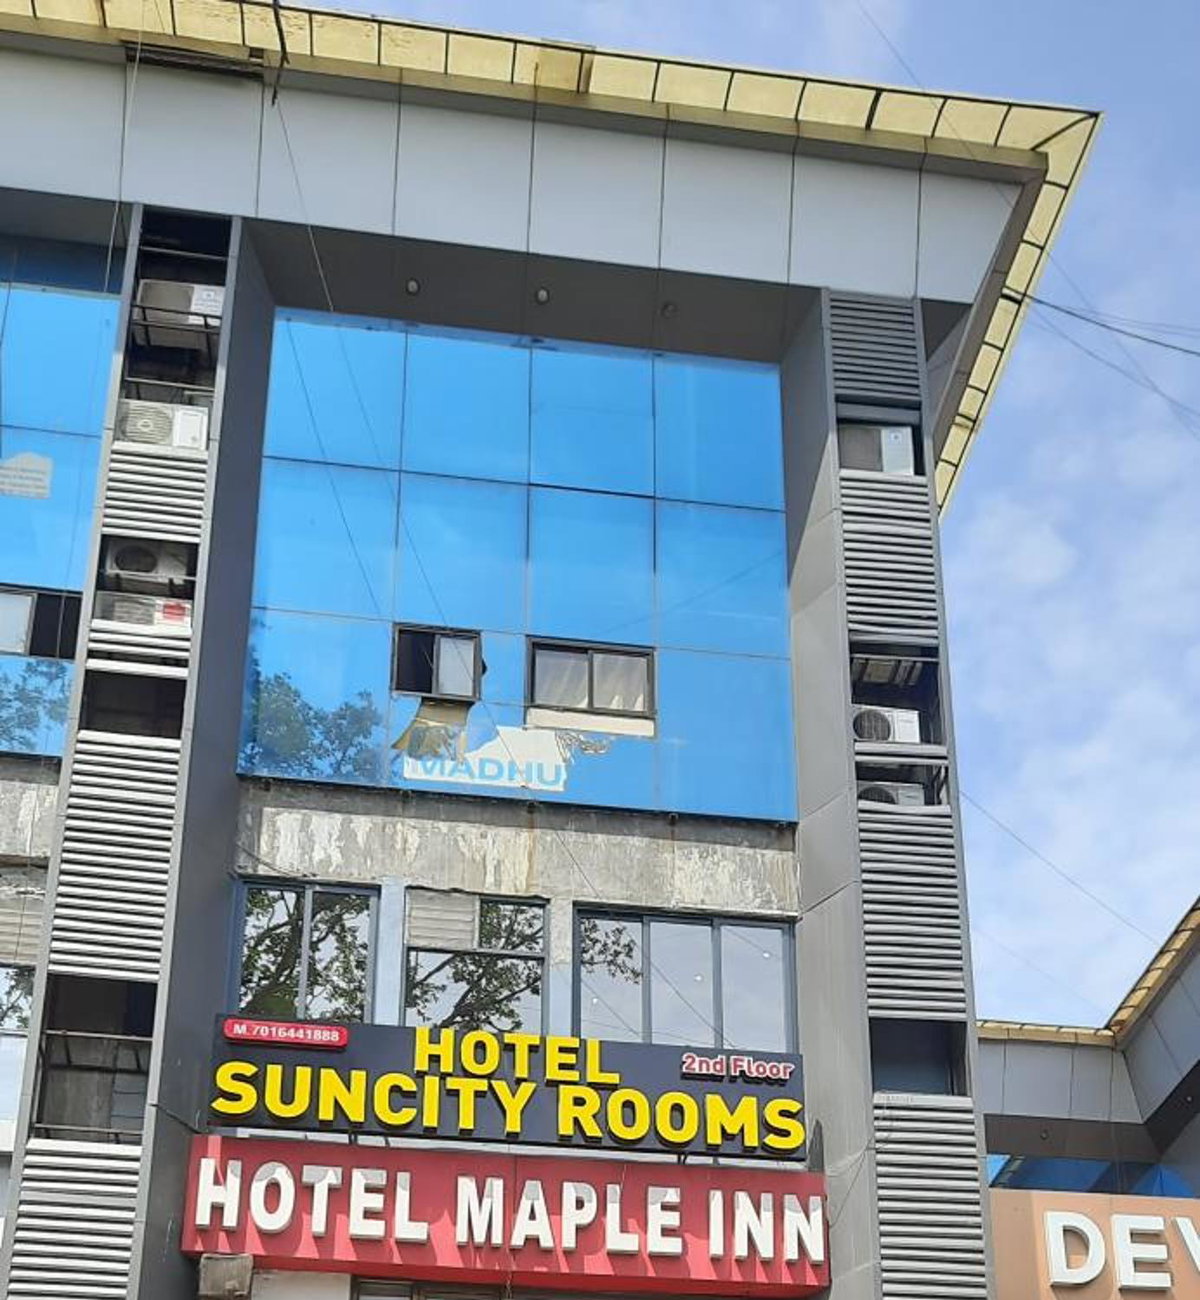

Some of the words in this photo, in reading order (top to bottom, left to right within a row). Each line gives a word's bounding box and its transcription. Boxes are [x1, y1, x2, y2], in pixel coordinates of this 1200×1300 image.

[232, 1023, 341, 1042] M.7016441888
[413, 1025, 622, 1085] HOTEL
[682, 1052, 726, 1076] 2nd
[729, 1055, 795, 1079] Floor
[210, 1060, 536, 1135] SUNCITY
[557, 1083, 808, 1150] ROOMS
[194, 1156, 430, 1245] HOTEL
[454, 1174, 684, 1257] MAPLE
[707, 1189, 826, 1265] INN
